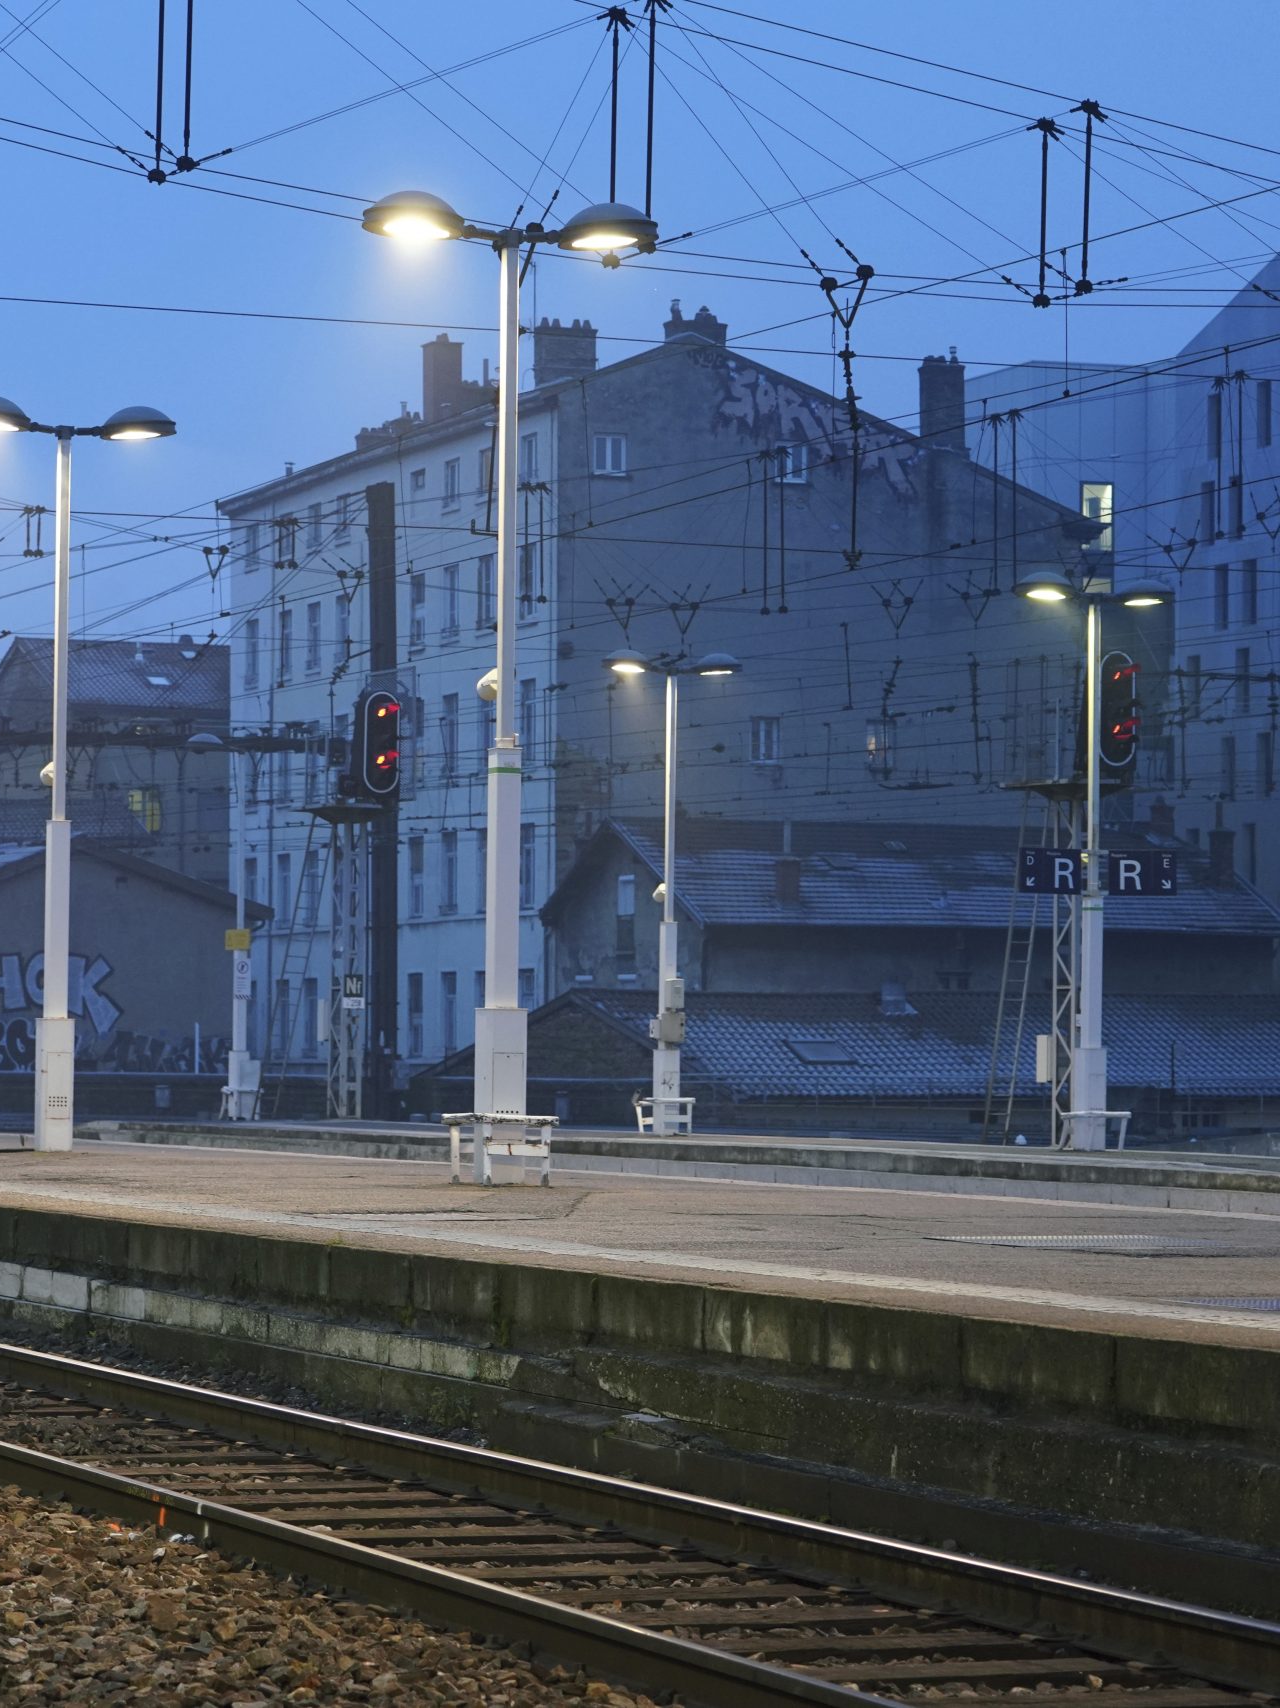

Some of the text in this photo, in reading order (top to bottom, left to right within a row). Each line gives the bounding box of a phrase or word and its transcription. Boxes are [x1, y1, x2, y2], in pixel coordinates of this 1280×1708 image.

[1026, 855, 1035, 866] D
[1162, 858, 1171, 869] E
[1054, 857, 1074, 889] R
[1119, 859, 1142, 891] R
[346, 976, 363, 995] Nr
